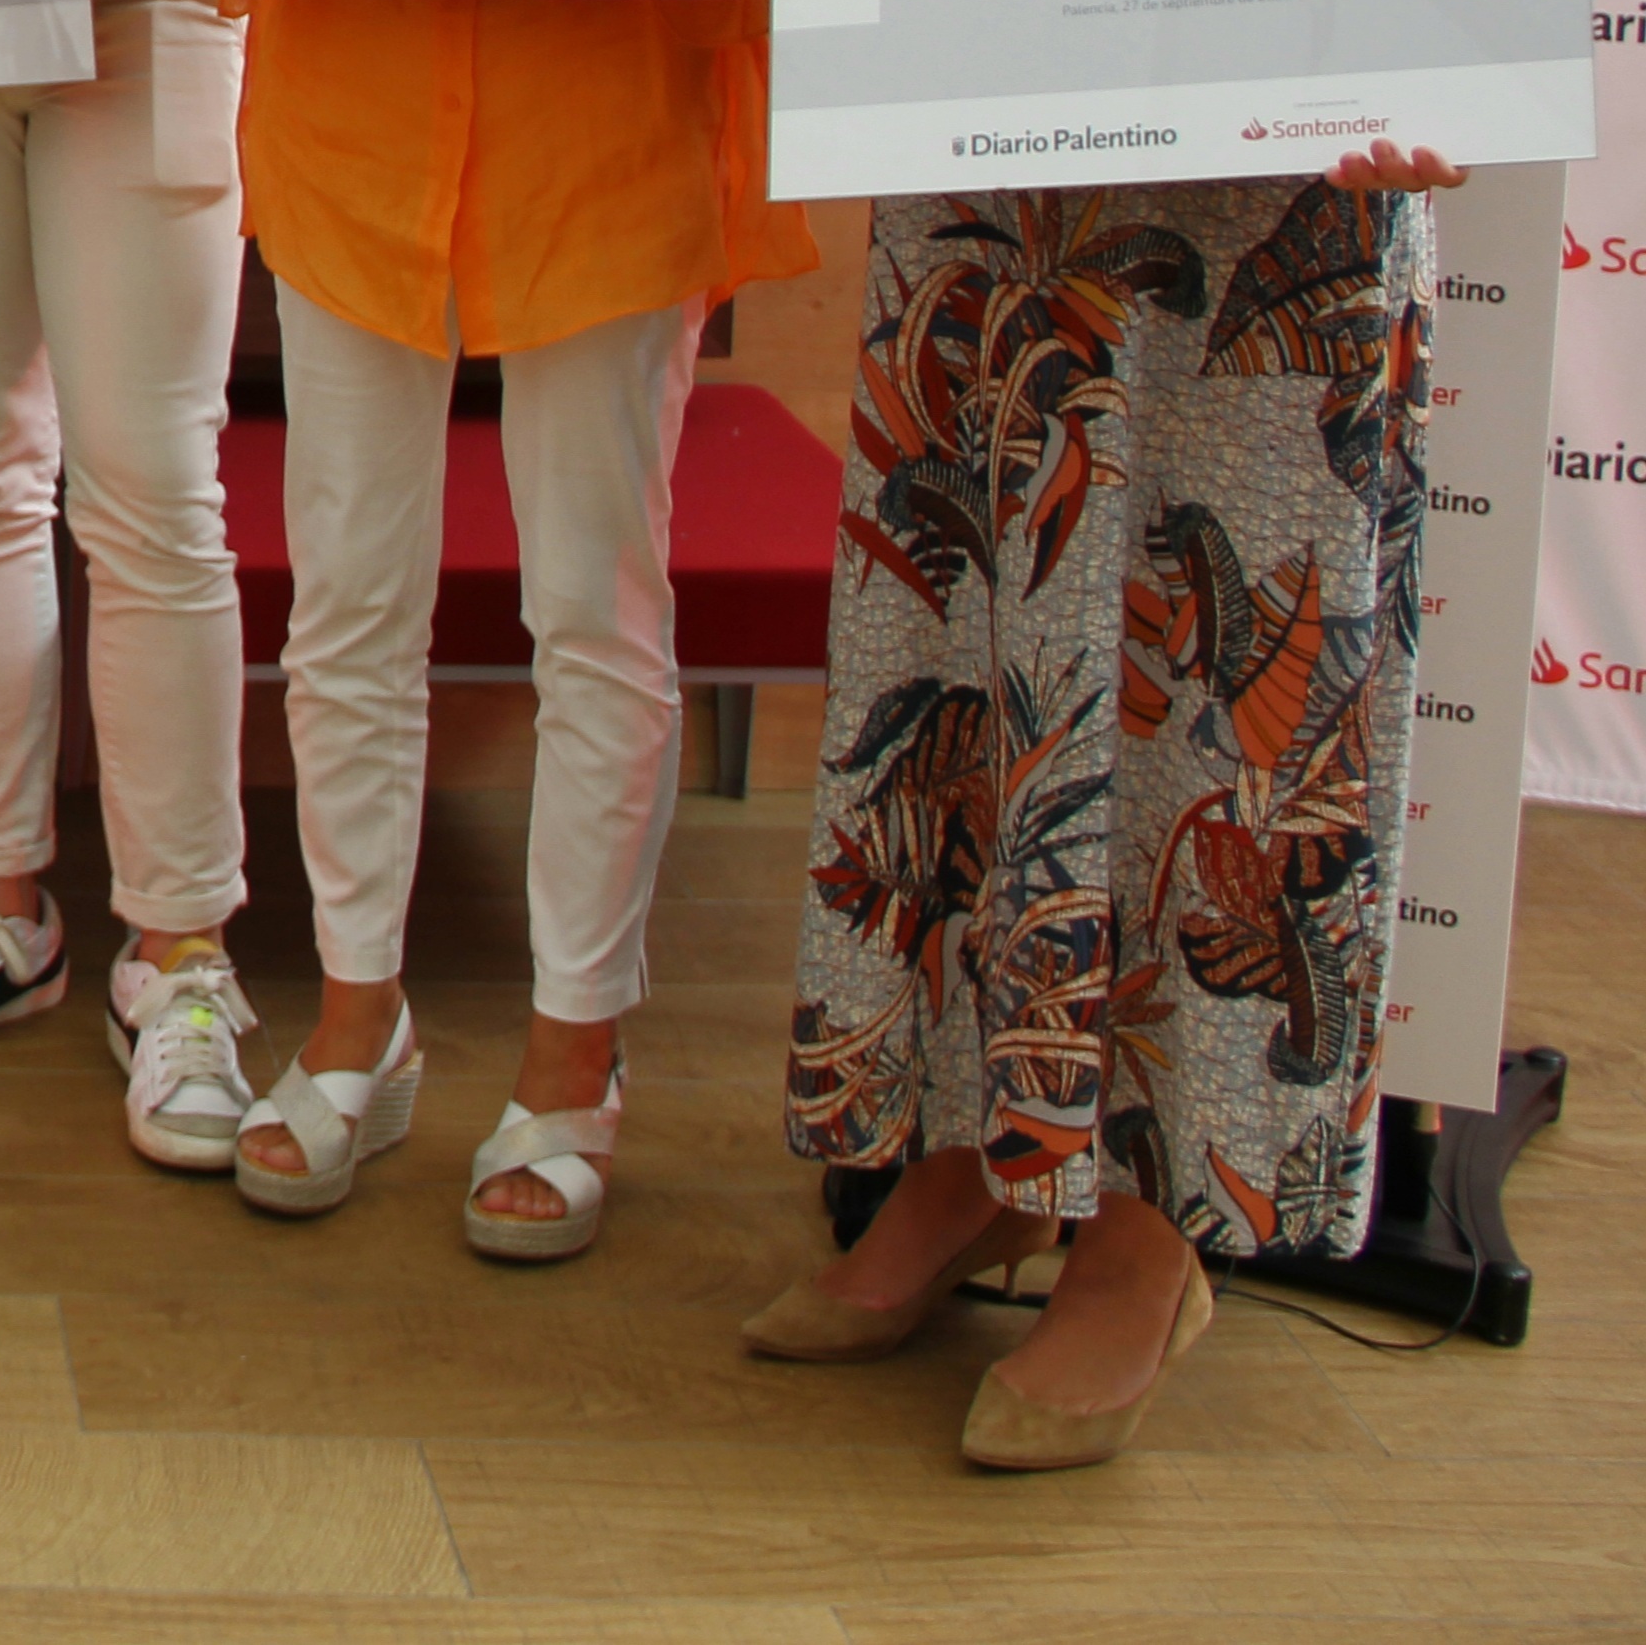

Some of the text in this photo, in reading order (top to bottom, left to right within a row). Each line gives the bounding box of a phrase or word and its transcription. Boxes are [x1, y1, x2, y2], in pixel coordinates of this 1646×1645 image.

[1122, 0, 1139, 12] 27
[1142, 0, 1158, 11] de
[971, 123, 1178, 157] Diario Palentino
[1272, 115, 1390, 140] Santander
[1547, 435, 1646, 485] iario
